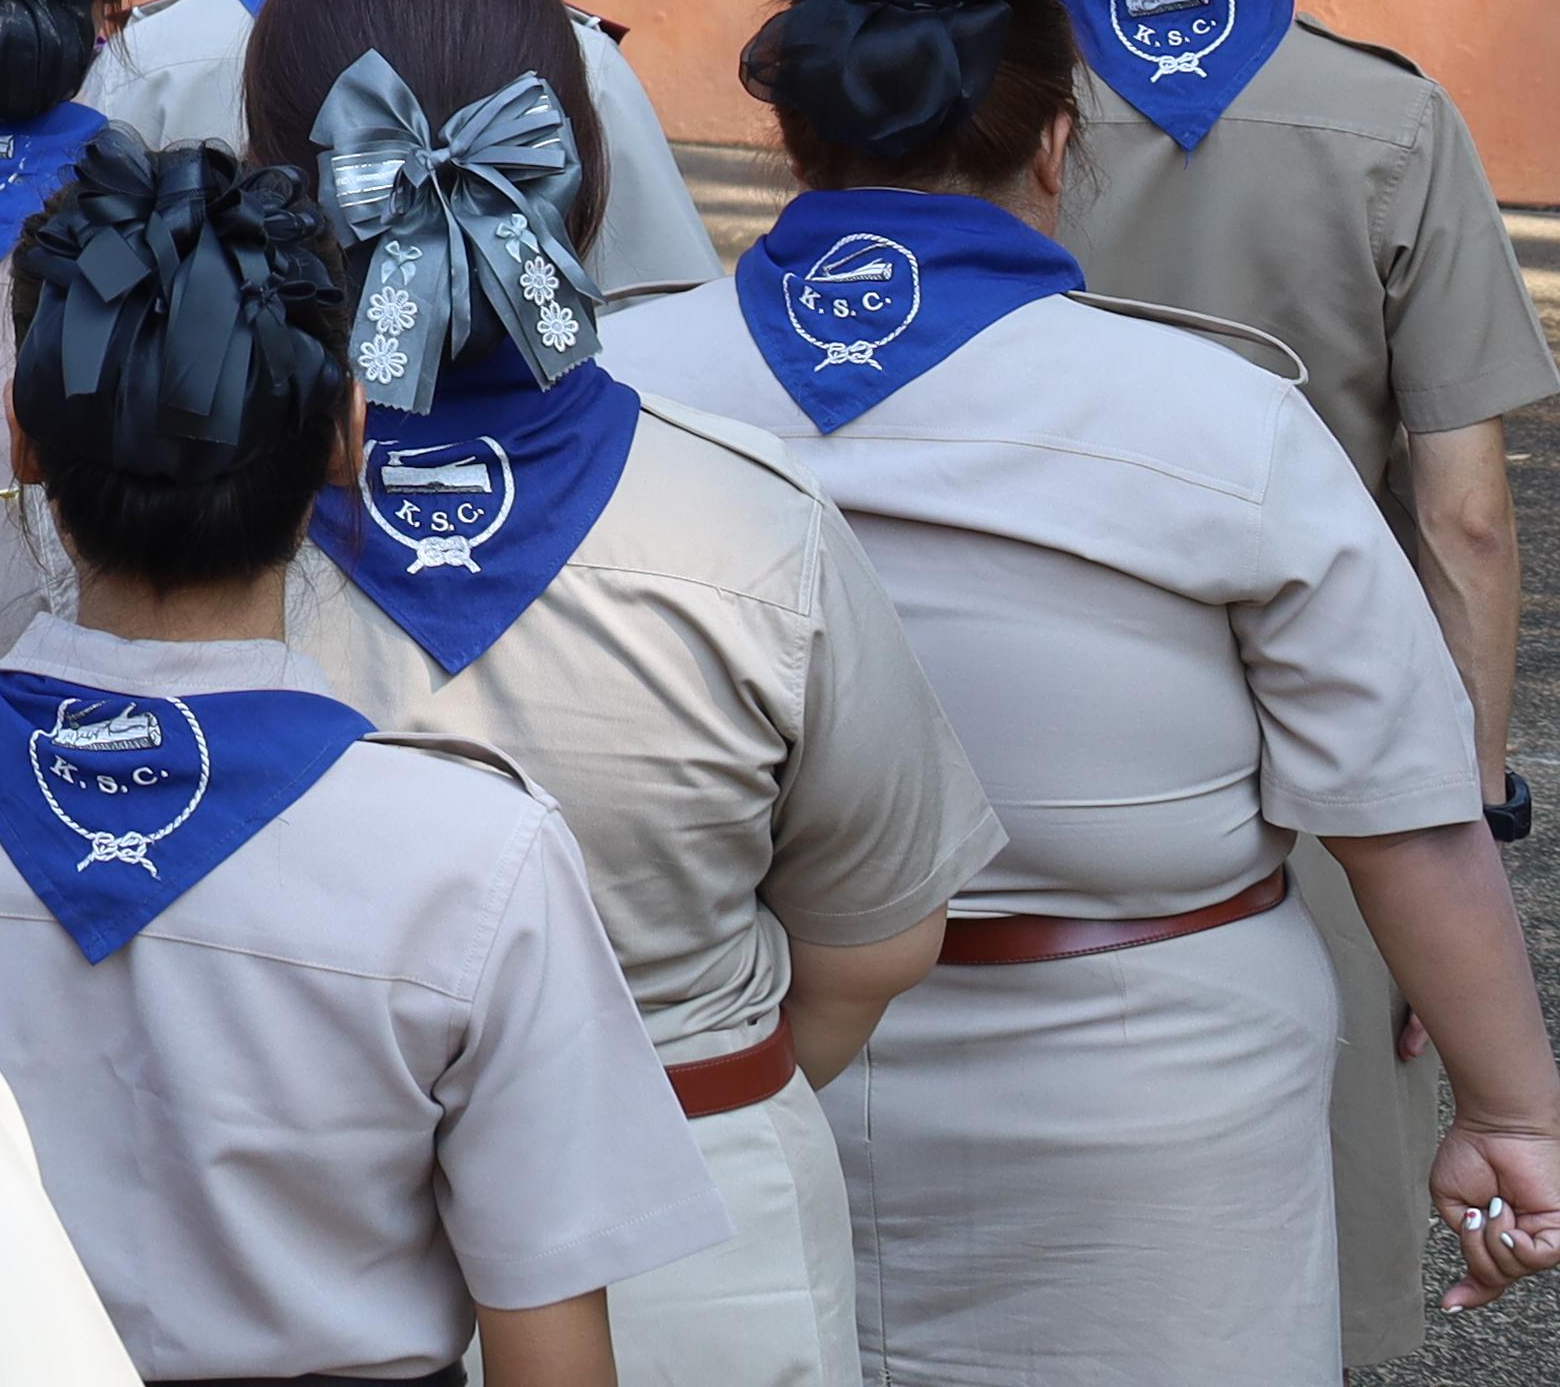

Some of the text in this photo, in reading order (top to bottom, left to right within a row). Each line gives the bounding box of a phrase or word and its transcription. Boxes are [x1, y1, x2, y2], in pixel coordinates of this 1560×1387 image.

[1134, 18, 1217, 46] K.S.C.
[800, 287, 893, 318] K.S.C.
[399, 499, 485, 533] K.S.C.
[52, 761, 169, 794] K.S.C.
